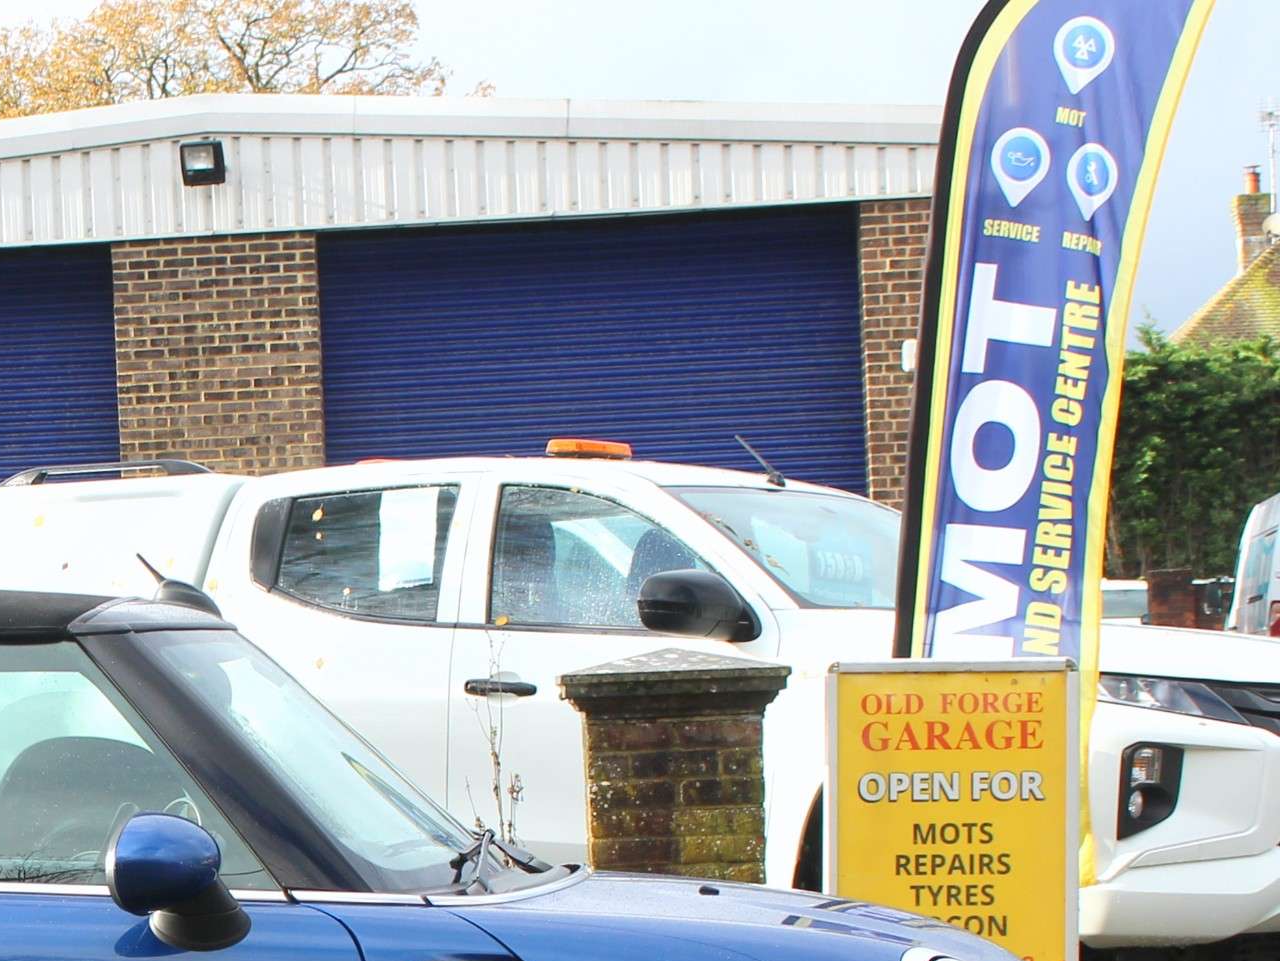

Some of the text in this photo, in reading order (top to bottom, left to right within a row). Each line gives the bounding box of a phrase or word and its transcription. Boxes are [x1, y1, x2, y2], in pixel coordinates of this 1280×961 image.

[1056, 106, 1087, 127] MOT
[983, 219, 1040, 243] SERVICE
[1052, 280, 1100, 427] CENTRE
[933, 263, 1057, 657] MOT
[1029, 432, 1078, 594] SERVICE
[860, 691, 1044, 715] OLD FORGE
[861, 719, 1044, 752] GARAGE
[857, 771, 1045, 802] OPEN FOR
[912, 822, 994, 845] MOTS
[895, 853, 1011, 876] REPAIRS
[910, 884, 995, 906] TYRES
